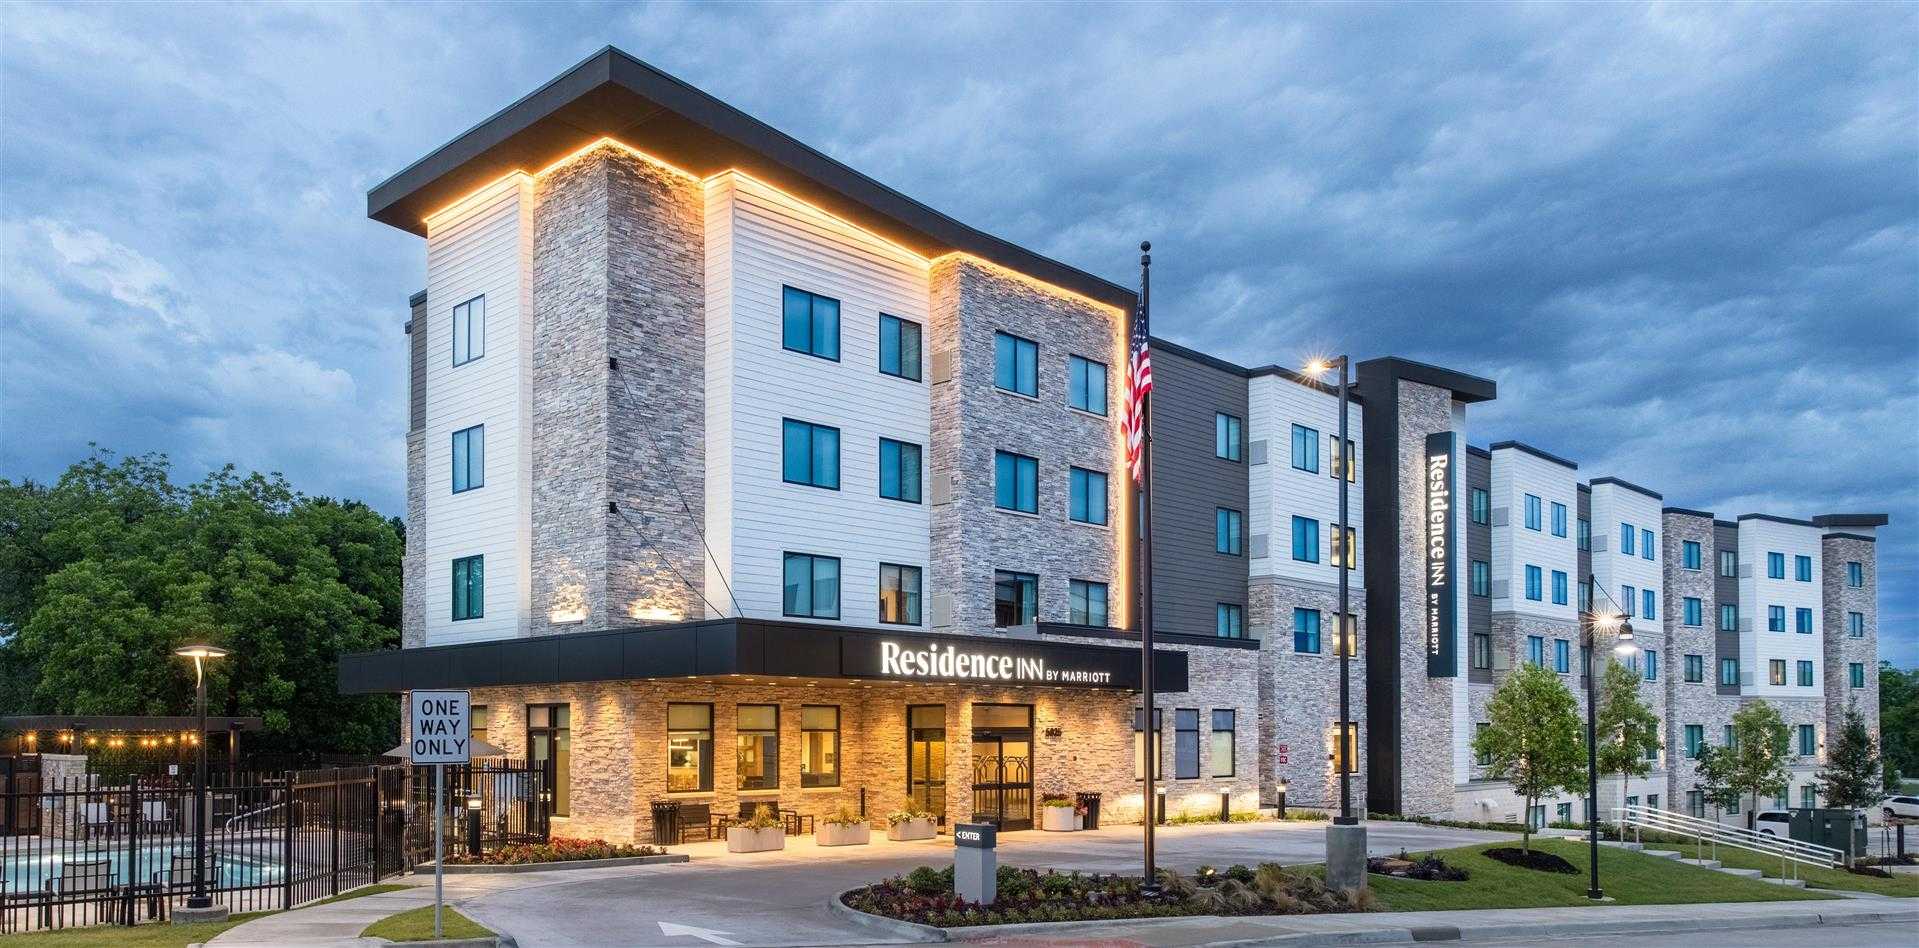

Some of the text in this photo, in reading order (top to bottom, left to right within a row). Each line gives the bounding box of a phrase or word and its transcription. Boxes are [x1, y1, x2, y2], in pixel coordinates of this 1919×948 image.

[1430, 454, 1448, 655] Residence INN BY MARRIOTT
[881, 641, 1111, 683] Residence INN BY MARRIOTT
[422, 699, 459, 715] ONE
[420, 719, 461, 735] WAY
[415, 739, 466, 755] ONLY
[962, 831, 980, 841] ENTER
